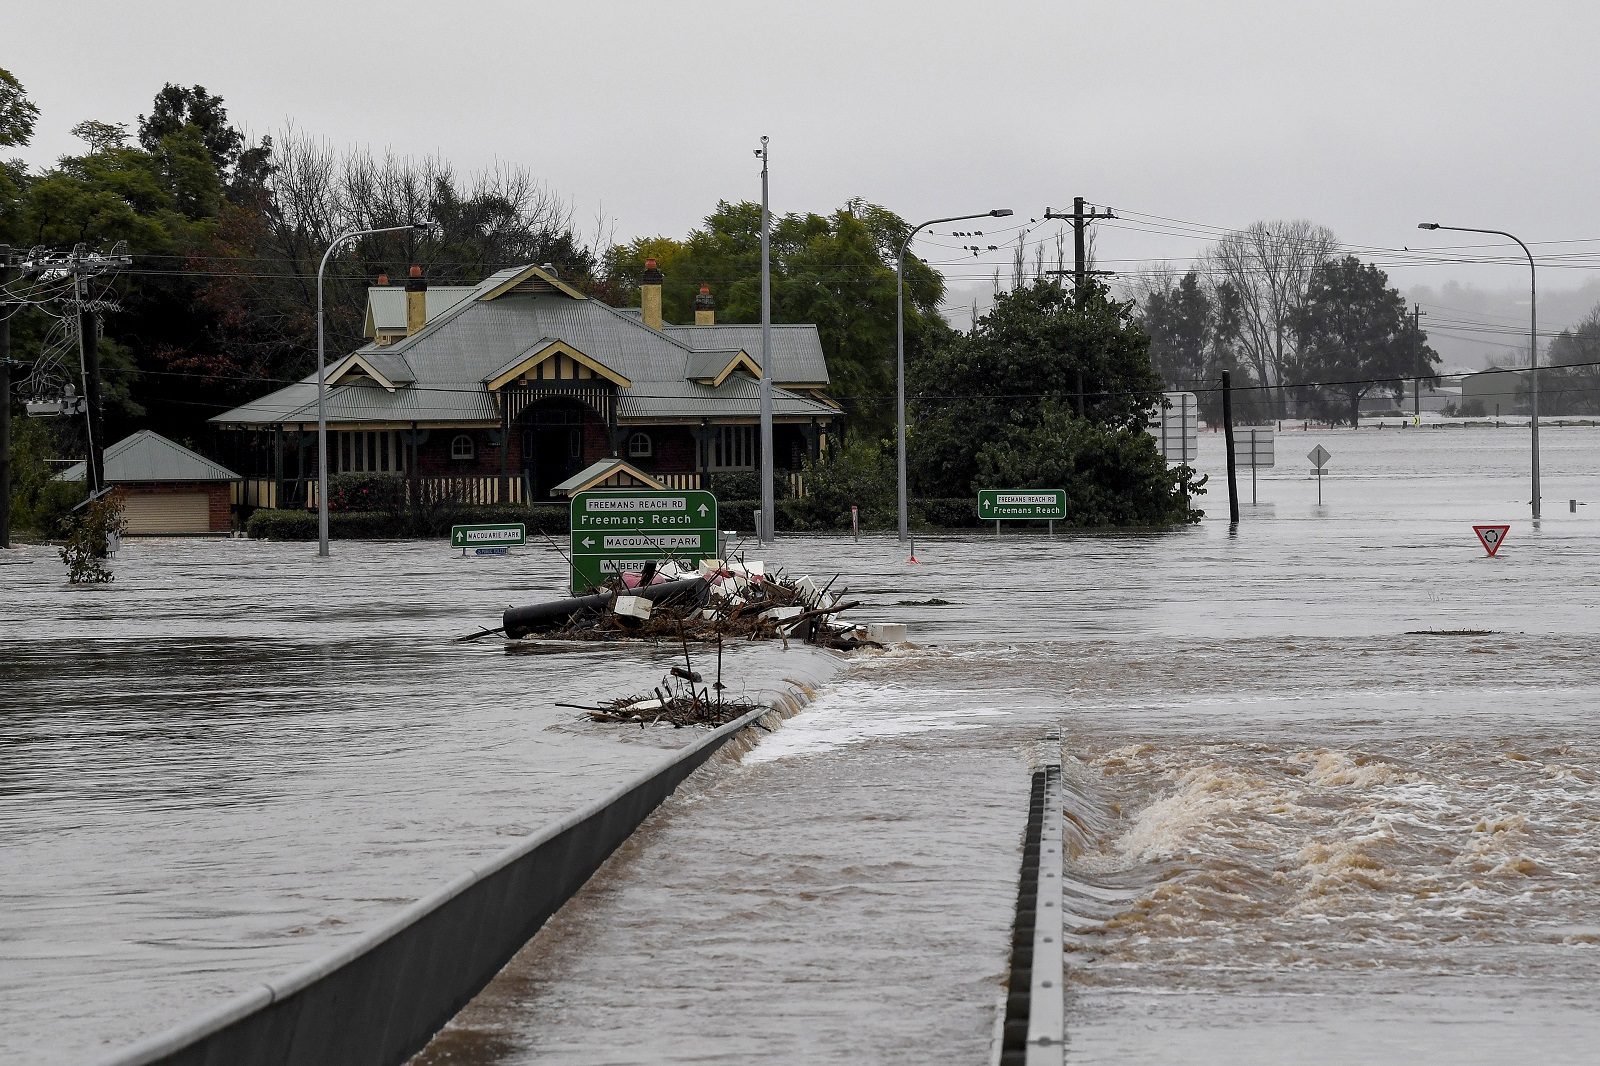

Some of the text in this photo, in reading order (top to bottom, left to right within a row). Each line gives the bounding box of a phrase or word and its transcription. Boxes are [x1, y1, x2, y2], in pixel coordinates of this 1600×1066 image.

[588, 501, 635, 509] FREEMANS
[672, 500, 683, 508] RD
[1036, 506, 1060, 514] Reach
[581, 514, 691, 525] Freemans Reach
[606, 537, 697, 546] MACQUARIE PARK
